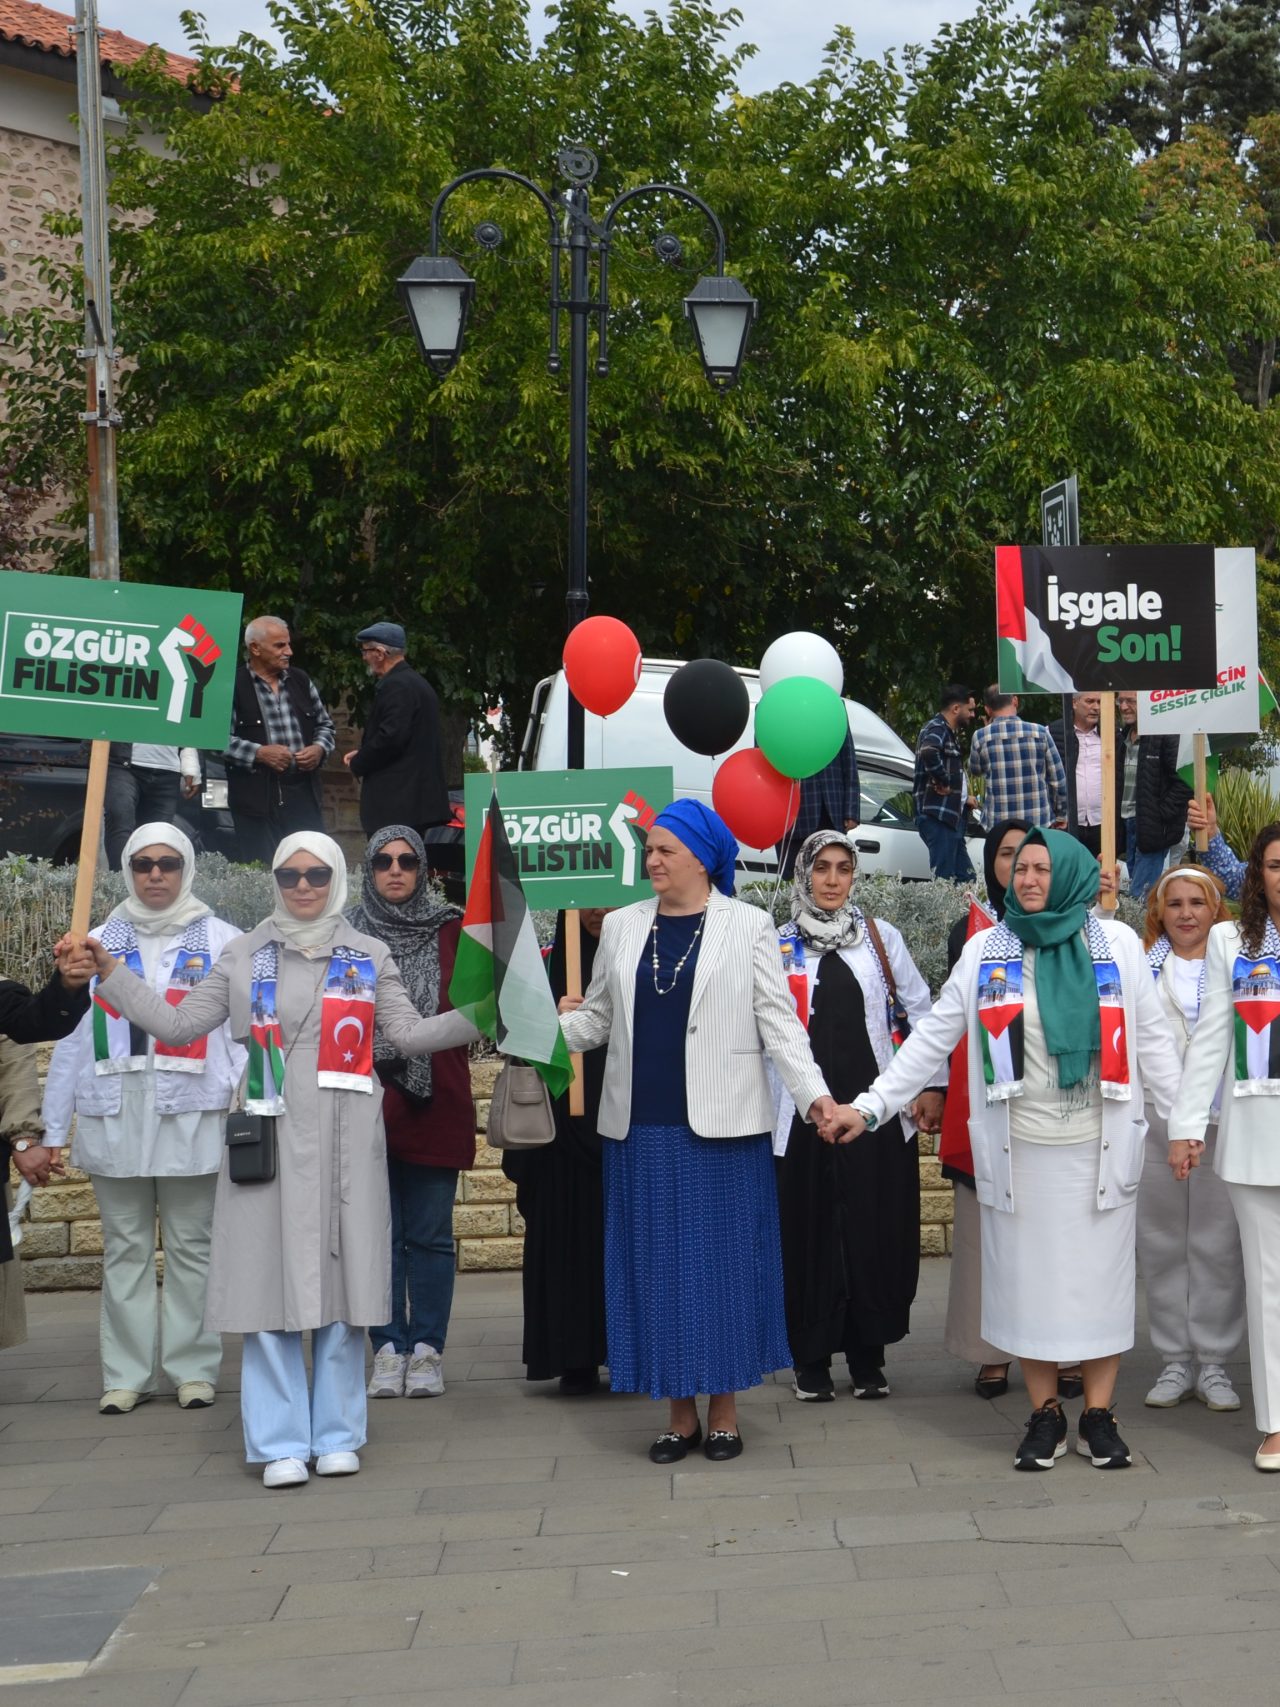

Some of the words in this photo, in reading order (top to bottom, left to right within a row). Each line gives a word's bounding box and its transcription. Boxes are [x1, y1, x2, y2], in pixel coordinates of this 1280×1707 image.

[1048, 575, 1162, 630] İşgale
[24, 622, 150, 667] ÖZGÜR
[1097, 625, 1182, 663] Son!
[1217, 666, 1246, 686] ÇİN
[1150, 694, 1197, 716] SESSİZ
[503, 812, 602, 844] ÖZGÜR
